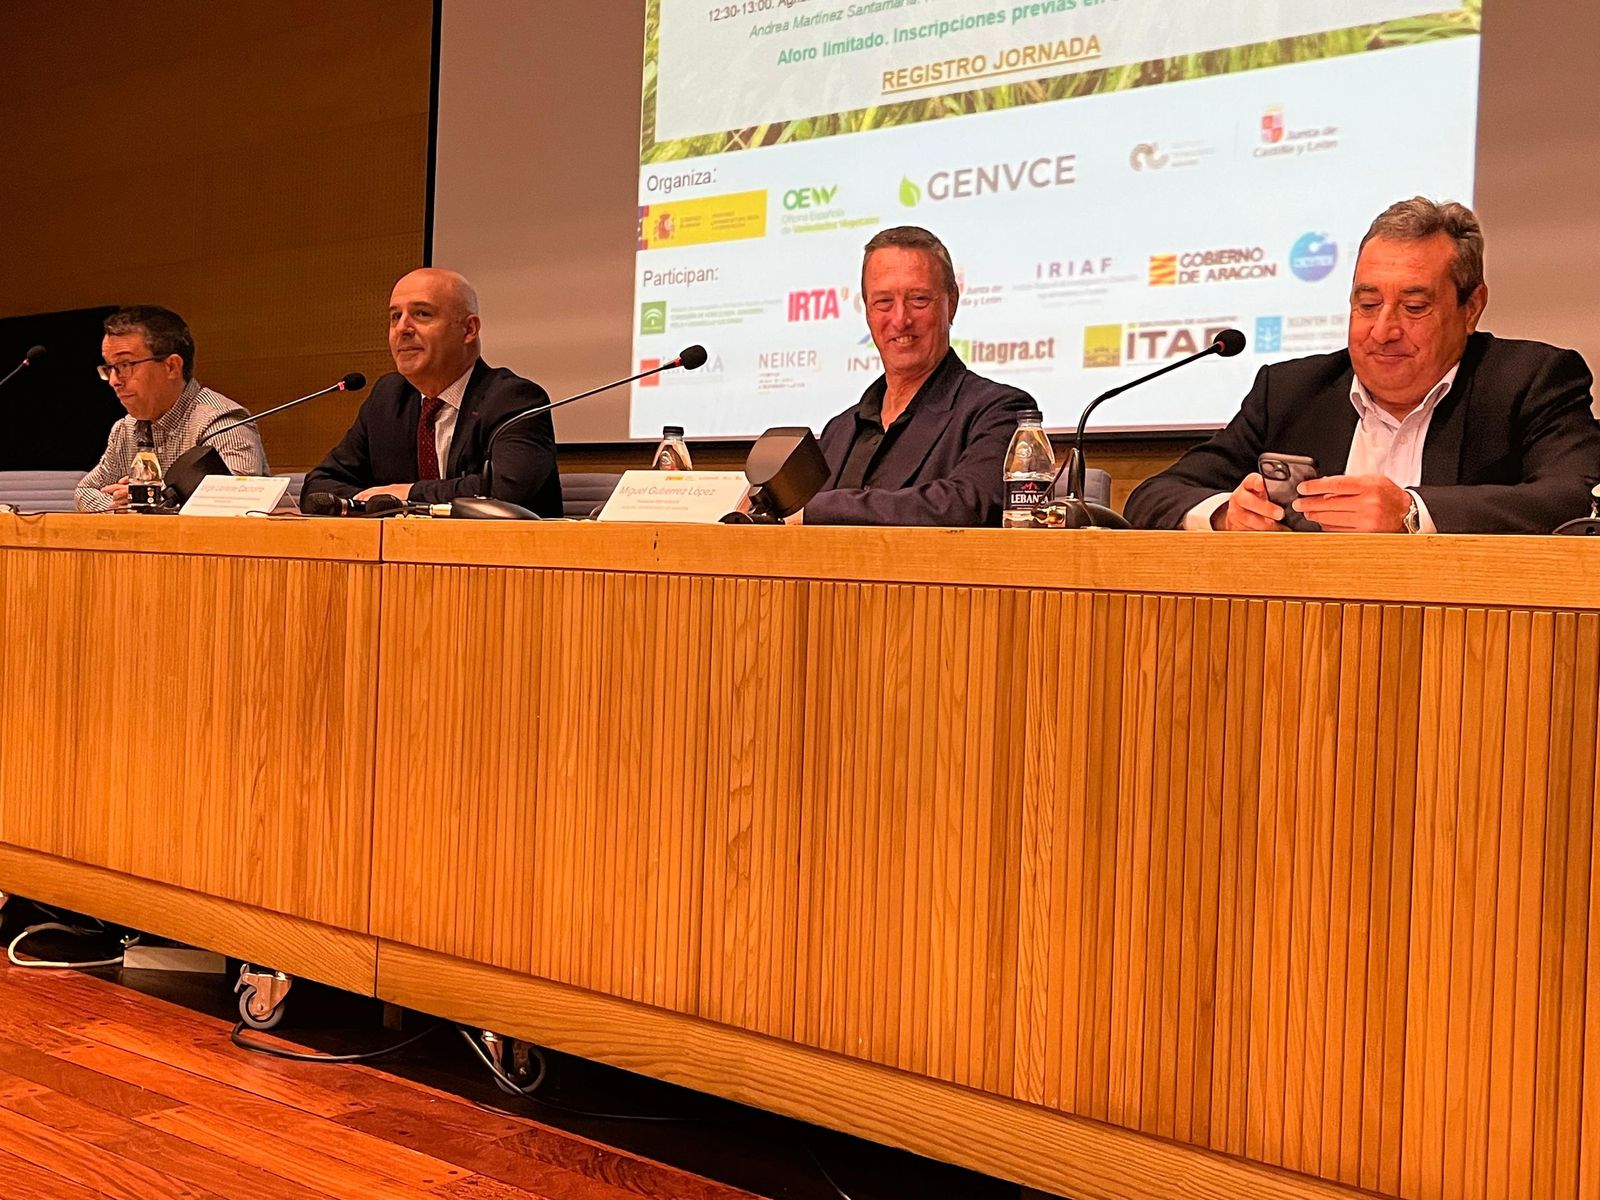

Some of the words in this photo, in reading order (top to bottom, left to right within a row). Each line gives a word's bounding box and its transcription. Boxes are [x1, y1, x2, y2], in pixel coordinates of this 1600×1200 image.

[708, 0, 775, 23] 12:30-13:00.
[749, 22, 790, 39] Andrea
[777, 46, 818, 66] Aforo
[822, 32, 889, 57] limitado.
[893, 11, 1006, 44] Inscripciones
[1011, 0, 1076, 26] previas
[881, 54, 987, 94] REGISTRO
[993, 34, 1101, 70] JORNADA
[646, 168, 718, 194] Organiza:
[927, 154, 1077, 201] GENVCE
[1036, 257, 1113, 279] IRIAF
[1179, 247, 1264, 268] GOBIERNO
[643, 267, 719, 288] Participan:
[1178, 271, 1200, 285] DE
[787, 287, 840, 323] IRTA
[758, 350, 817, 369] NEIKER
[971, 337, 1055, 364] itagra.ct
[847, 355, 882, 373] INT
